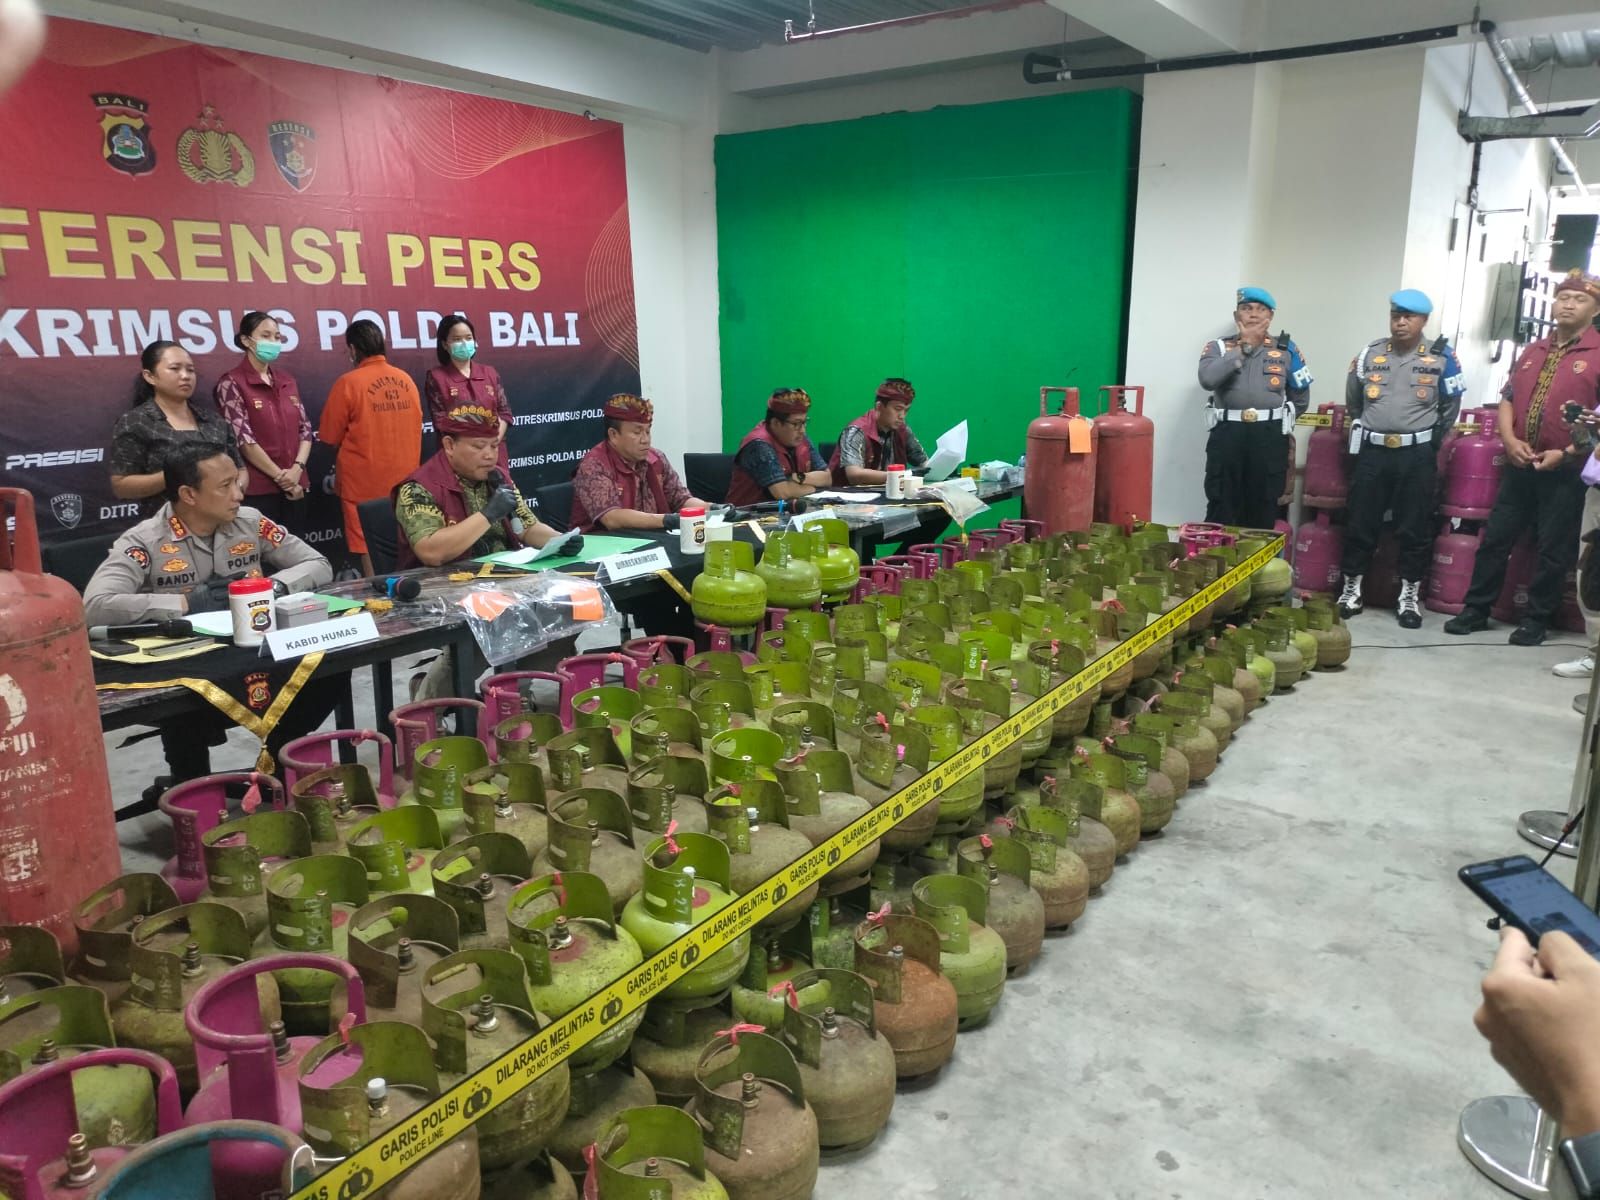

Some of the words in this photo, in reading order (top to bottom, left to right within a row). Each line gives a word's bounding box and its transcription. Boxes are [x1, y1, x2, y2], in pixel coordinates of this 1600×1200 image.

[98, 96, 145, 110] BALI
[386, 232, 541, 292] PERS
[316, 310, 478, 351] PLD
[489, 310, 581, 348] BALI
[581, 408, 605, 420] POLD
[5, 448, 104, 470] PRESISI
[546, 450, 574, 464] POLDA
[100, 503, 139, 520] DITR
[227, 552, 259, 570] POLRI
[285, 636, 319, 651] KABID
[321, 627, 358, 642] HUMAS
[842, 822, 867, 848] DILARANG
[867, 806, 890, 830] MELINTAS
[790, 862, 807, 882] GARIS
[808, 850, 826, 870] POLISI
[702, 911, 736, 944] DILARANG
[738, 888, 769, 918] MELINTAS
[626, 966, 652, 995] GARIS
[653, 948, 678, 975] POLISI
[638, 982, 656, 999] POLICE
[657, 972, 668, 989] LINE
[496, 1039, 548, 1085] DILARANG
[549, 1006, 595, 1048] MELINTAS
[526, 1065, 536, 1078] DO
[537, 1055, 550, 1071] NOT
[550, 1041, 571, 1061] CROSS
[380, 1124, 420, 1162] GARIS
[421, 1097, 459, 1135] POLISI
[399, 1142, 426, 1165] POLICE
[427, 1126, 445, 1149] LINE
